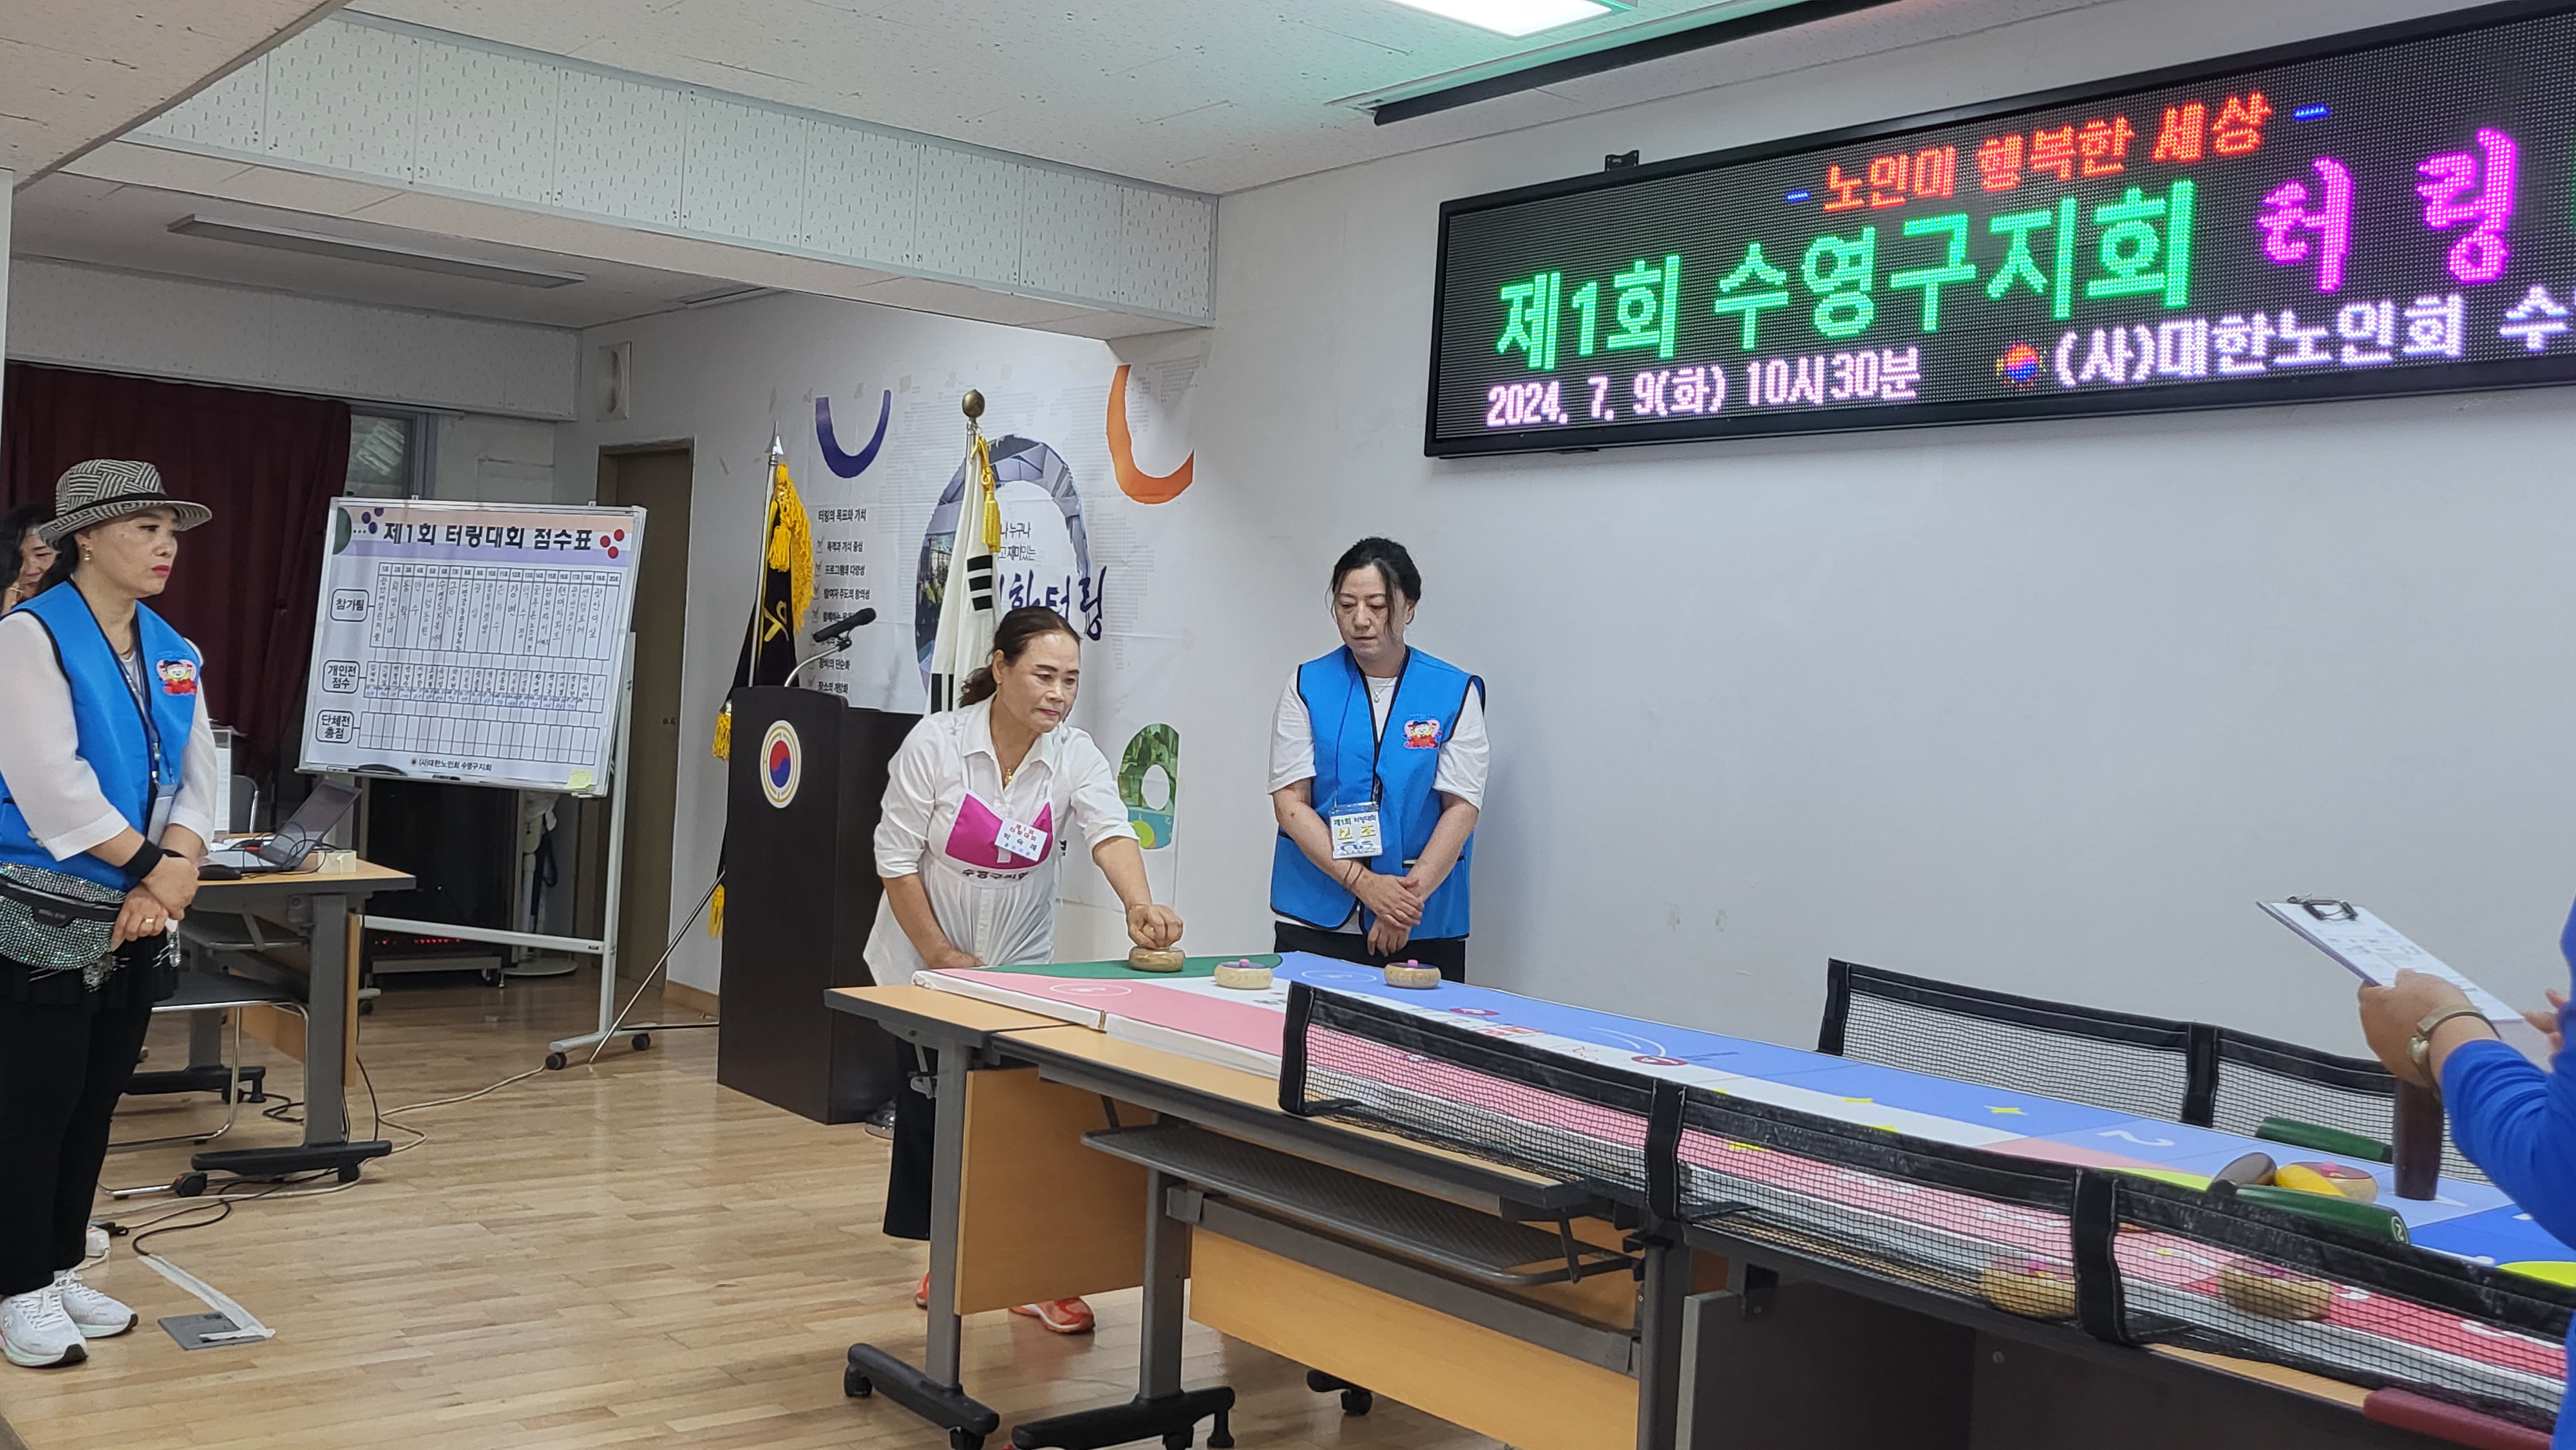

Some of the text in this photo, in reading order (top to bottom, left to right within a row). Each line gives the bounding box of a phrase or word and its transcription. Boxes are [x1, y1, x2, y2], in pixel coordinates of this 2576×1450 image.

[1976, 115, 2135, 192] 행복한
[2152, 91, 2273, 164] 세상
[1497, 254, 1680, 370] 제1회
[1714, 178, 2195, 351] 수영구지회
[2054, 284, 2576, 388] (사)대한노인회 수
[1486, 346, 1921, 428] 2024. 7. 9(화) 10시30분
[819, 508, 867, 522] 터링의 목표와 가치
[383, 523, 592, 551] 제1회 터링대회 점수표
[1009, 522, 1031, 538] 누구나
[1007, 545, 1036, 561] 재미있는
[336, 598, 365, 611] 참가팀
[1046, 565, 1107, 641] 터링
[327, 664, 356, 677] 개인전
[332, 677, 350, 690] 점수
[321, 715, 350, 728] 단체전
[325, 727, 345, 739] 총점
[461, 762, 492, 771] 수영구지회
